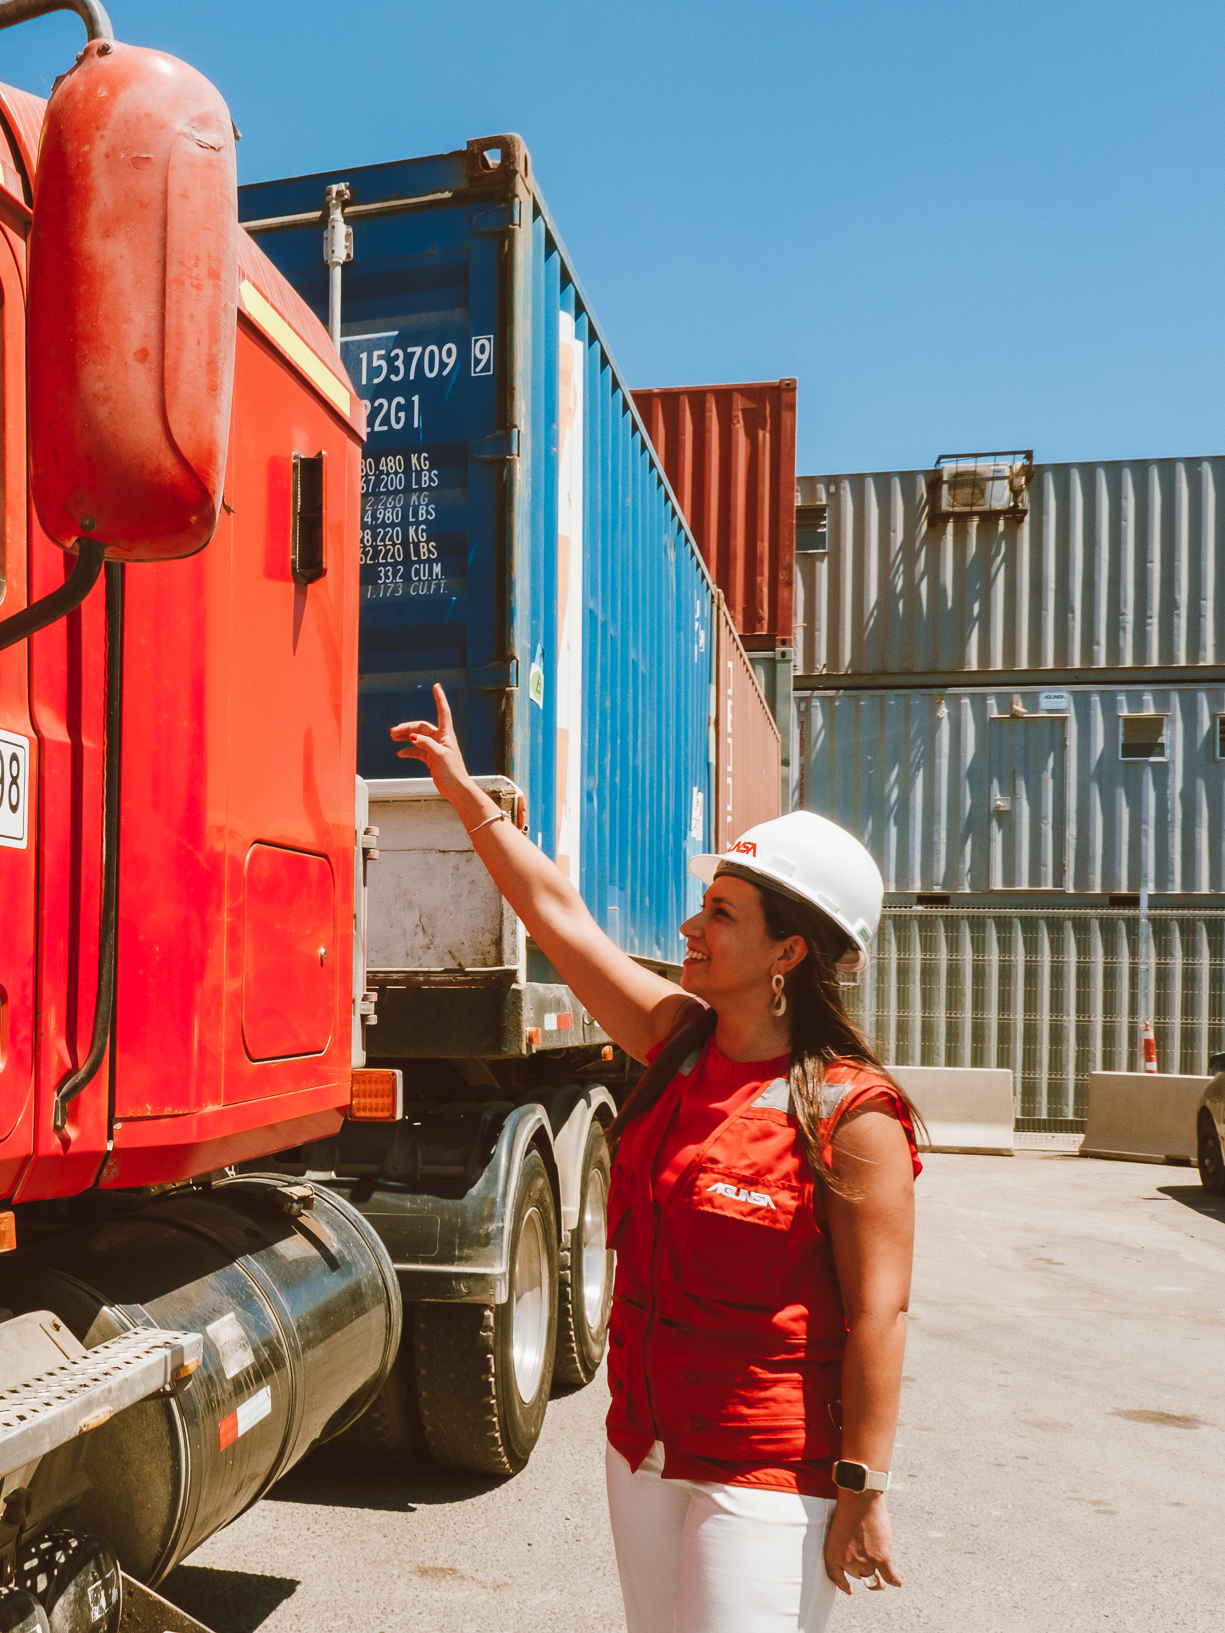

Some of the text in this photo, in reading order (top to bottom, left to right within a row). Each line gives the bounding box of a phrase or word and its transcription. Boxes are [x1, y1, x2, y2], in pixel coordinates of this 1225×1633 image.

[359, 337, 492, 386] 153709 9
[410, 452, 430, 471] KG
[412, 469, 439, 489] LBS
[410, 491, 429, 506] KG
[408, 504, 436, 521] LBS
[408, 524, 427, 543] KG
[409, 541, 438, 560] LBS
[377, 562, 446, 584] 33.2 CU.M.
